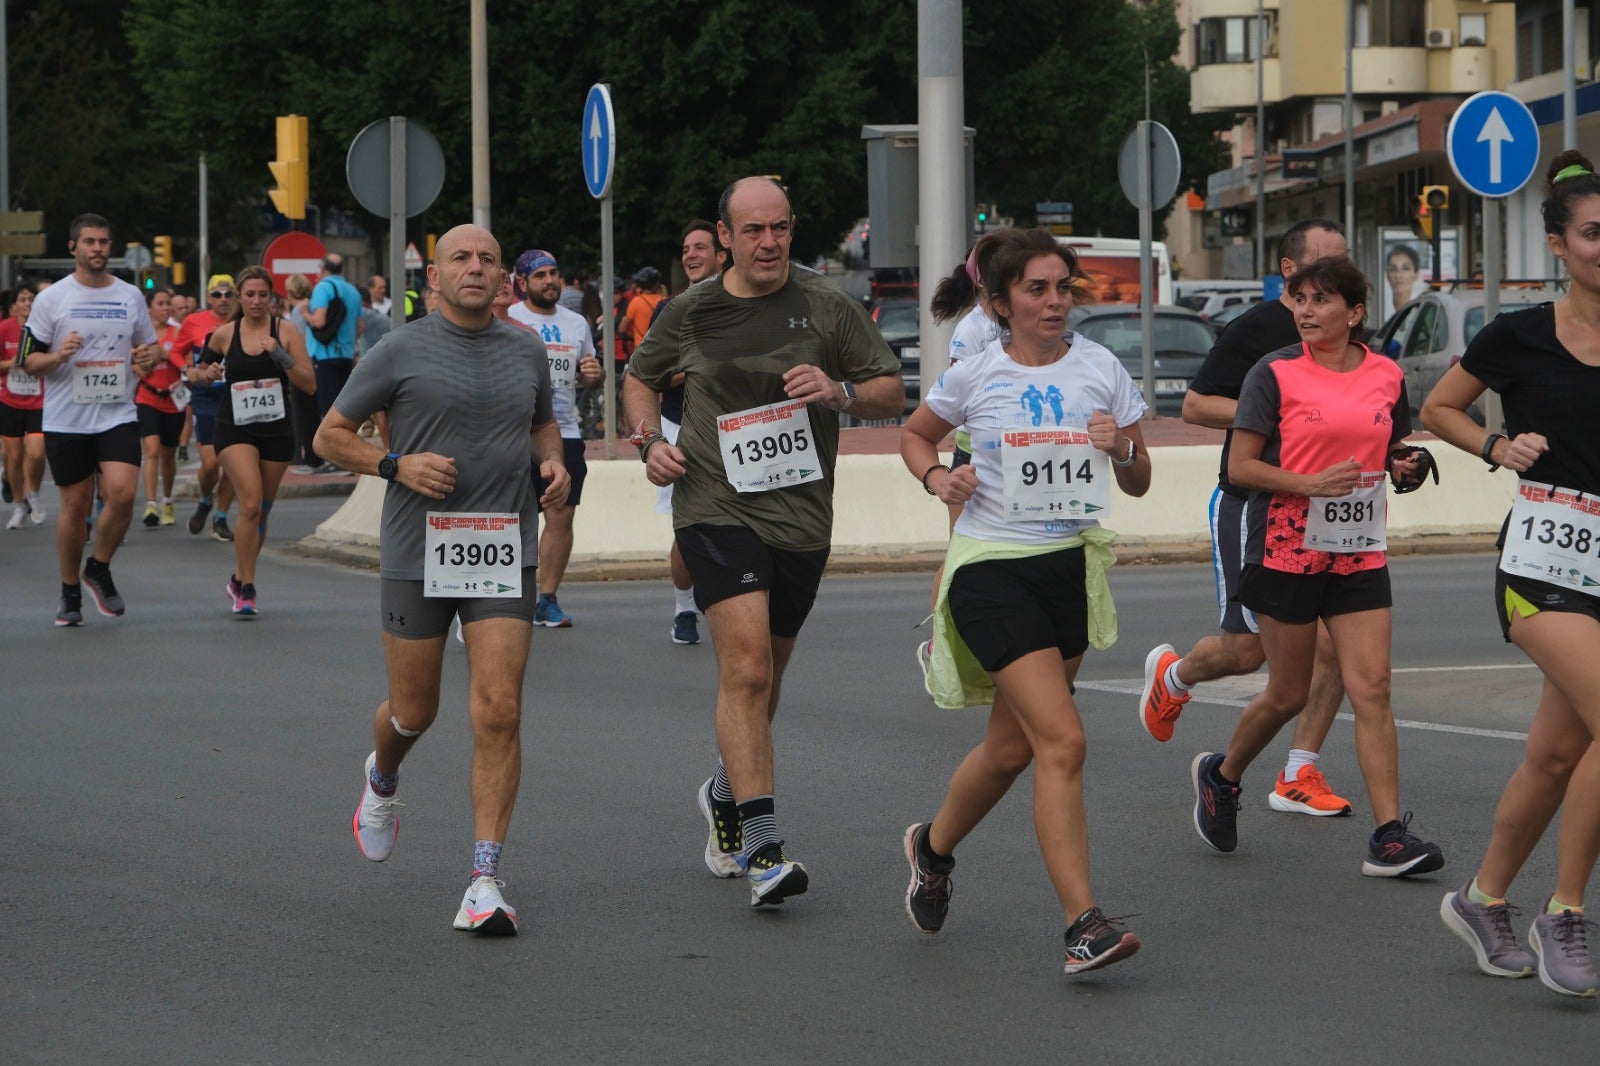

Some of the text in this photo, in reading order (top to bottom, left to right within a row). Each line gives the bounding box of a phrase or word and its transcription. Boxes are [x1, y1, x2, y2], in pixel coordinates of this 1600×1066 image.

[83, 373, 118, 387] 1742
[242, 394, 276, 409] 1743
[731, 429, 808, 466] 13905
[1004, 432, 1030, 447] 42
[1029, 431, 1070, 440] CARRERA
[1071, 431, 1089, 440] URB
[1021, 459, 1094, 486] 9114
[1520, 484, 1547, 504] 42
[1324, 500, 1374, 523] 6381
[429, 516, 451, 531] 42
[434, 543, 515, 566] 13903
